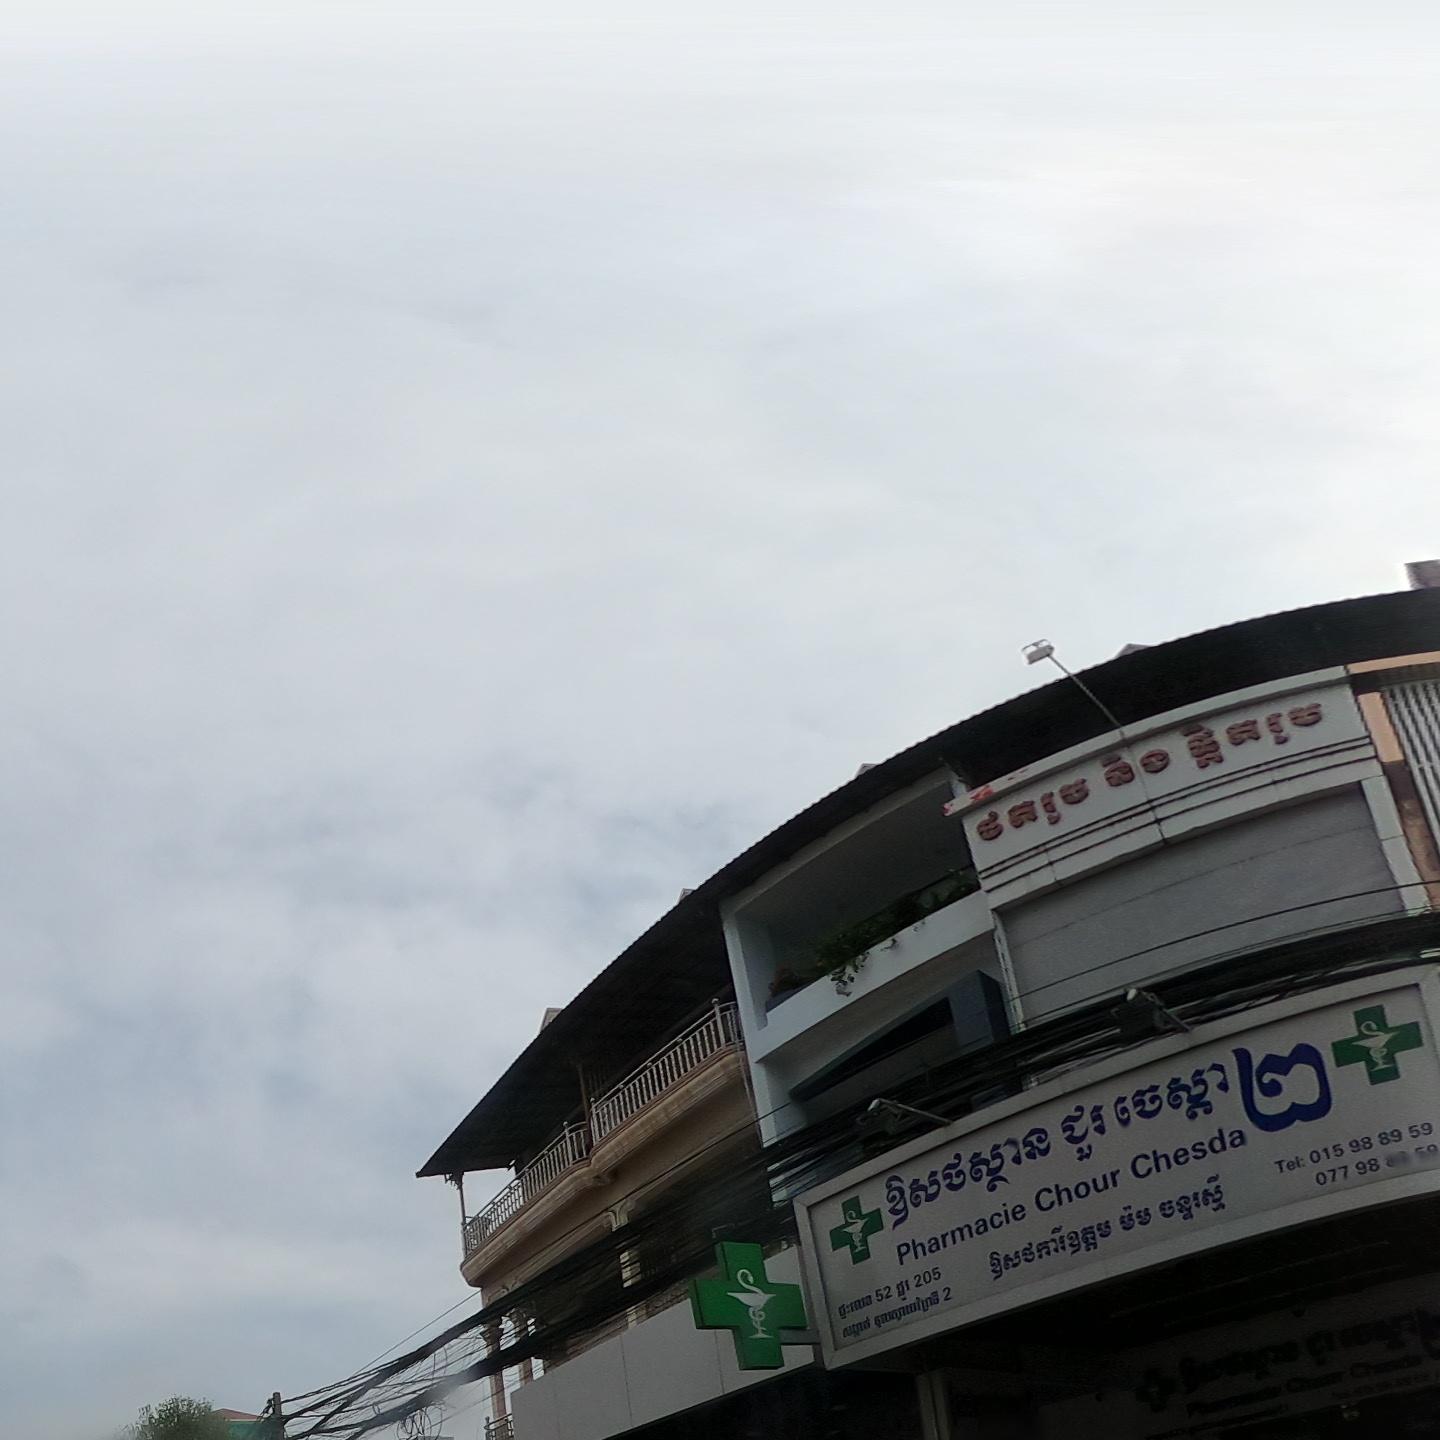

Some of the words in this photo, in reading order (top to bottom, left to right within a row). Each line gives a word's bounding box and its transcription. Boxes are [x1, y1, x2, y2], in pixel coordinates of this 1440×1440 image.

[1232, 1043, 1332, 1132] ២
[1309, 1144, 1344, 1164] 015
[1349, 1136, 1374, 1153] 98
[1378, 1129, 1403, 1146] 89
[1408, 1122, 1434, 1139] 59
[1315, 1165, 1349, 1186] 077
[1355, 1158, 1380, 1176] 98
[896, 1203, 1026, 1265] Pharmacie
[1035, 1168, 1121, 1212] Chour
[1131, 1127, 1247, 1179] Chesda
[875, 1285, 893, 1302] 52
[914, 1267, 941, 1288] 205
[943, 1287, 952, 1301] 2
